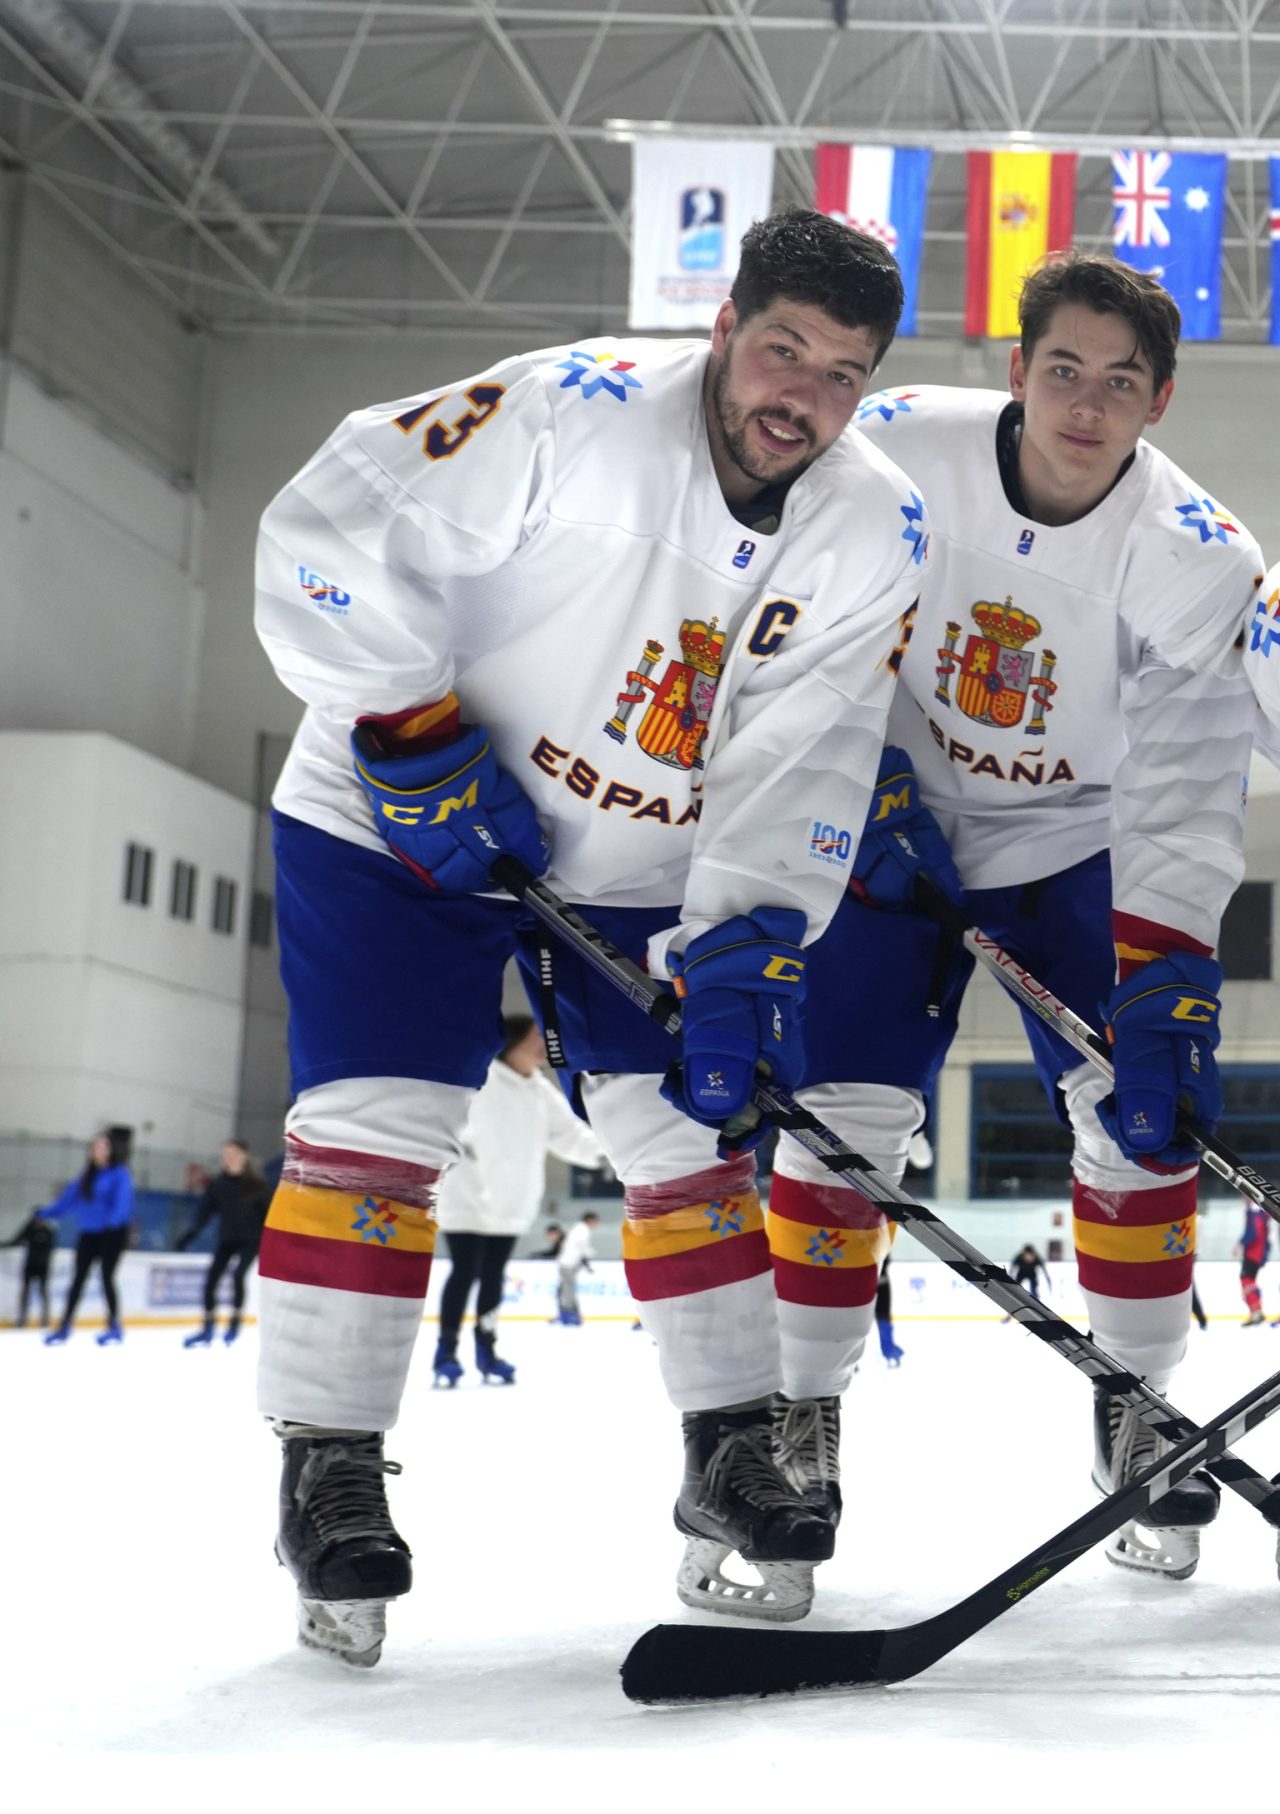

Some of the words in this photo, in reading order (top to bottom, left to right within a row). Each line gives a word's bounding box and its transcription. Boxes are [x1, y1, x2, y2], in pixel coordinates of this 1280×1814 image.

[747, 598, 801, 658] C
[913, 696, 1076, 787] SPAÑA
[810, 821, 852, 860] 100
